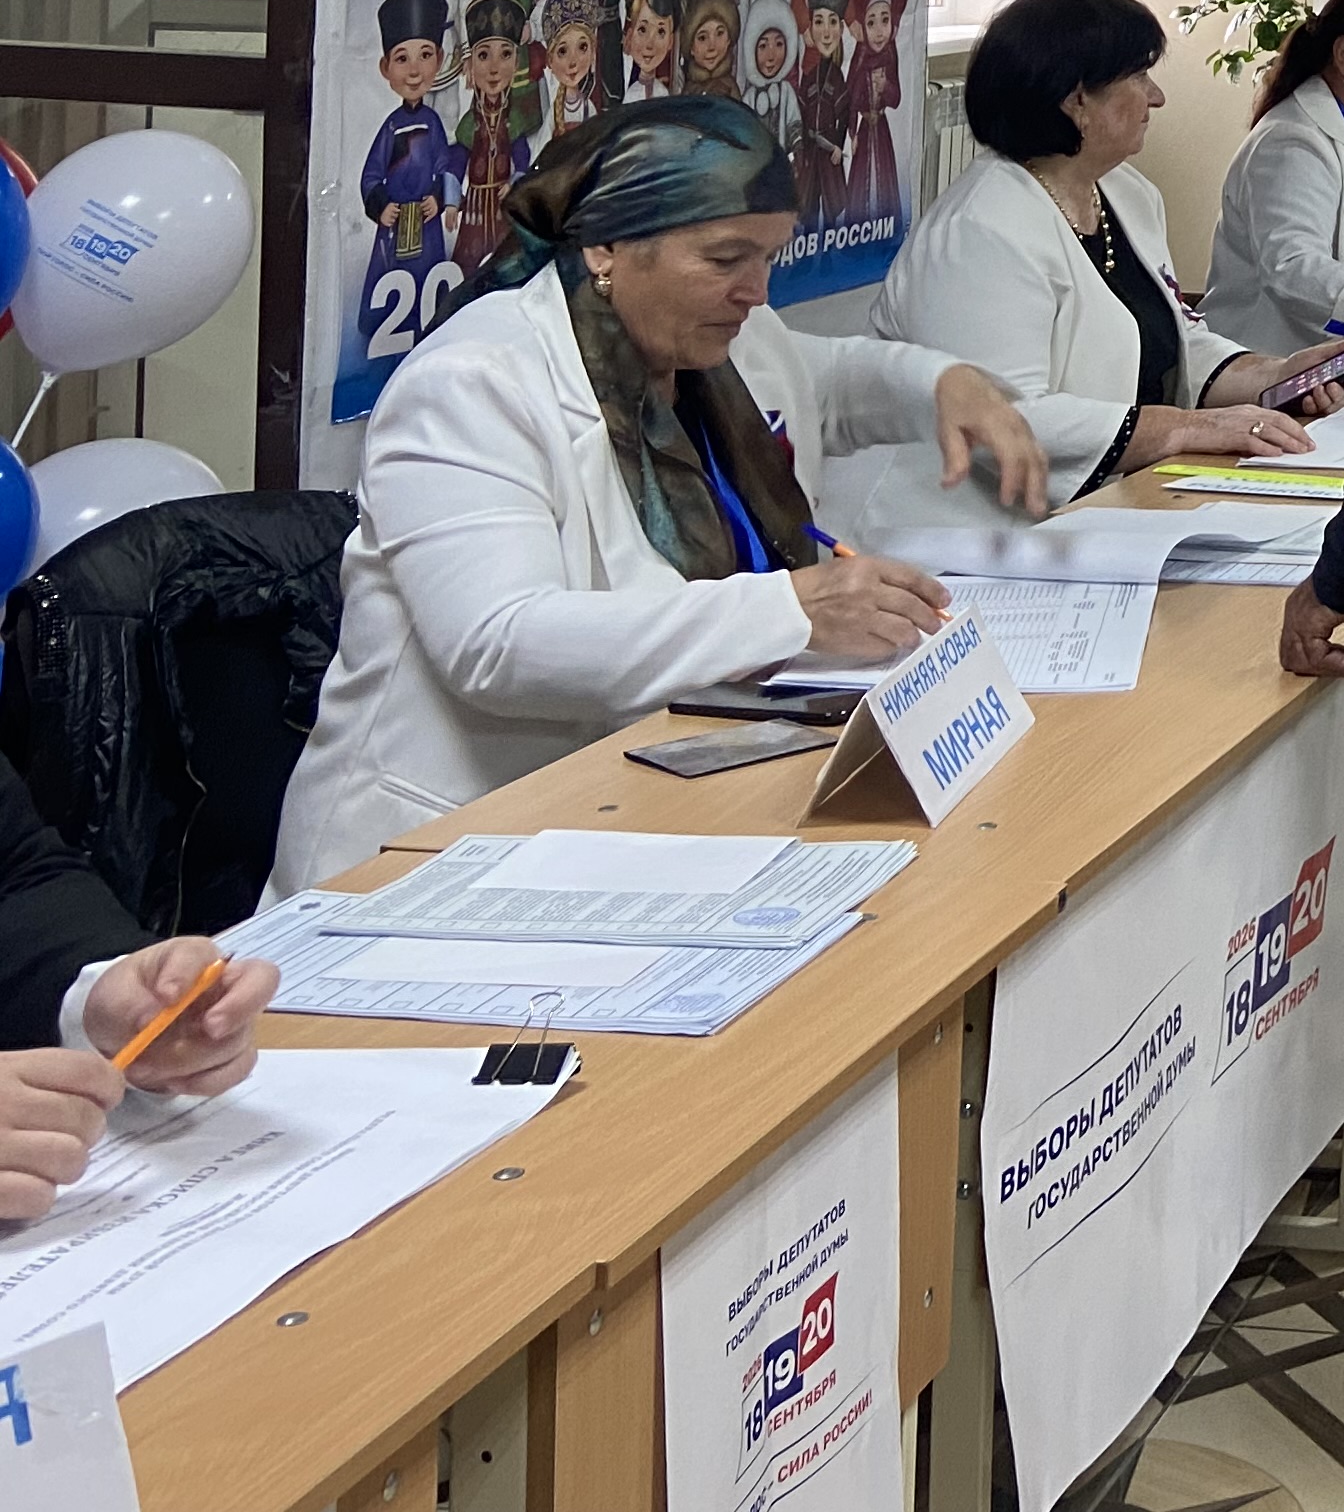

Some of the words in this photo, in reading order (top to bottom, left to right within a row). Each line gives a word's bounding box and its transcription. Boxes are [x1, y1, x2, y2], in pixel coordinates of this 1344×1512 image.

[70, 235, 87, 250] 18
[90, 239, 107, 253] 19
[108, 242, 131, 260] 20
[822, 215, 895, 253] РОССИИ
[922, 684, 1011, 791] МИРНАЯ
[1225, 978, 1251, 1047] 18
[1258, 921, 1287, 988] 19
[1291, 866, 1327, 936] 20
[1226, 916, 1257, 963] 2026
[1255, 965, 1321, 1042] СЕНТЯБРЯ
[1000, 1097, 1096, 1205] ВЫБОРЫ
[1099, 1003, 1182, 1127] ДЕПУТАТОВ
[1027, 1071, 1164, 1231] ГОСУДАРСТВЕННОЙ
[1164, 1035, 1197, 1096] ДУМЫ
[728, 1259, 774, 1323] ВЫБОРЫ
[776, 1198, 846, 1275] ДЕПУТАТОВ
[819, 1227, 849, 1268] ДУМЫ
[744, 1398, 763, 1453] 18
[765, 1348, 796, 1397] 19
[801, 1297, 833, 1357] 20
[768, 1368, 837, 1439] СЕНТЯБРЯ
[777, 1441, 820, 1483] СИЛА
[823, 1387, 874, 1451] РОССИИ!
